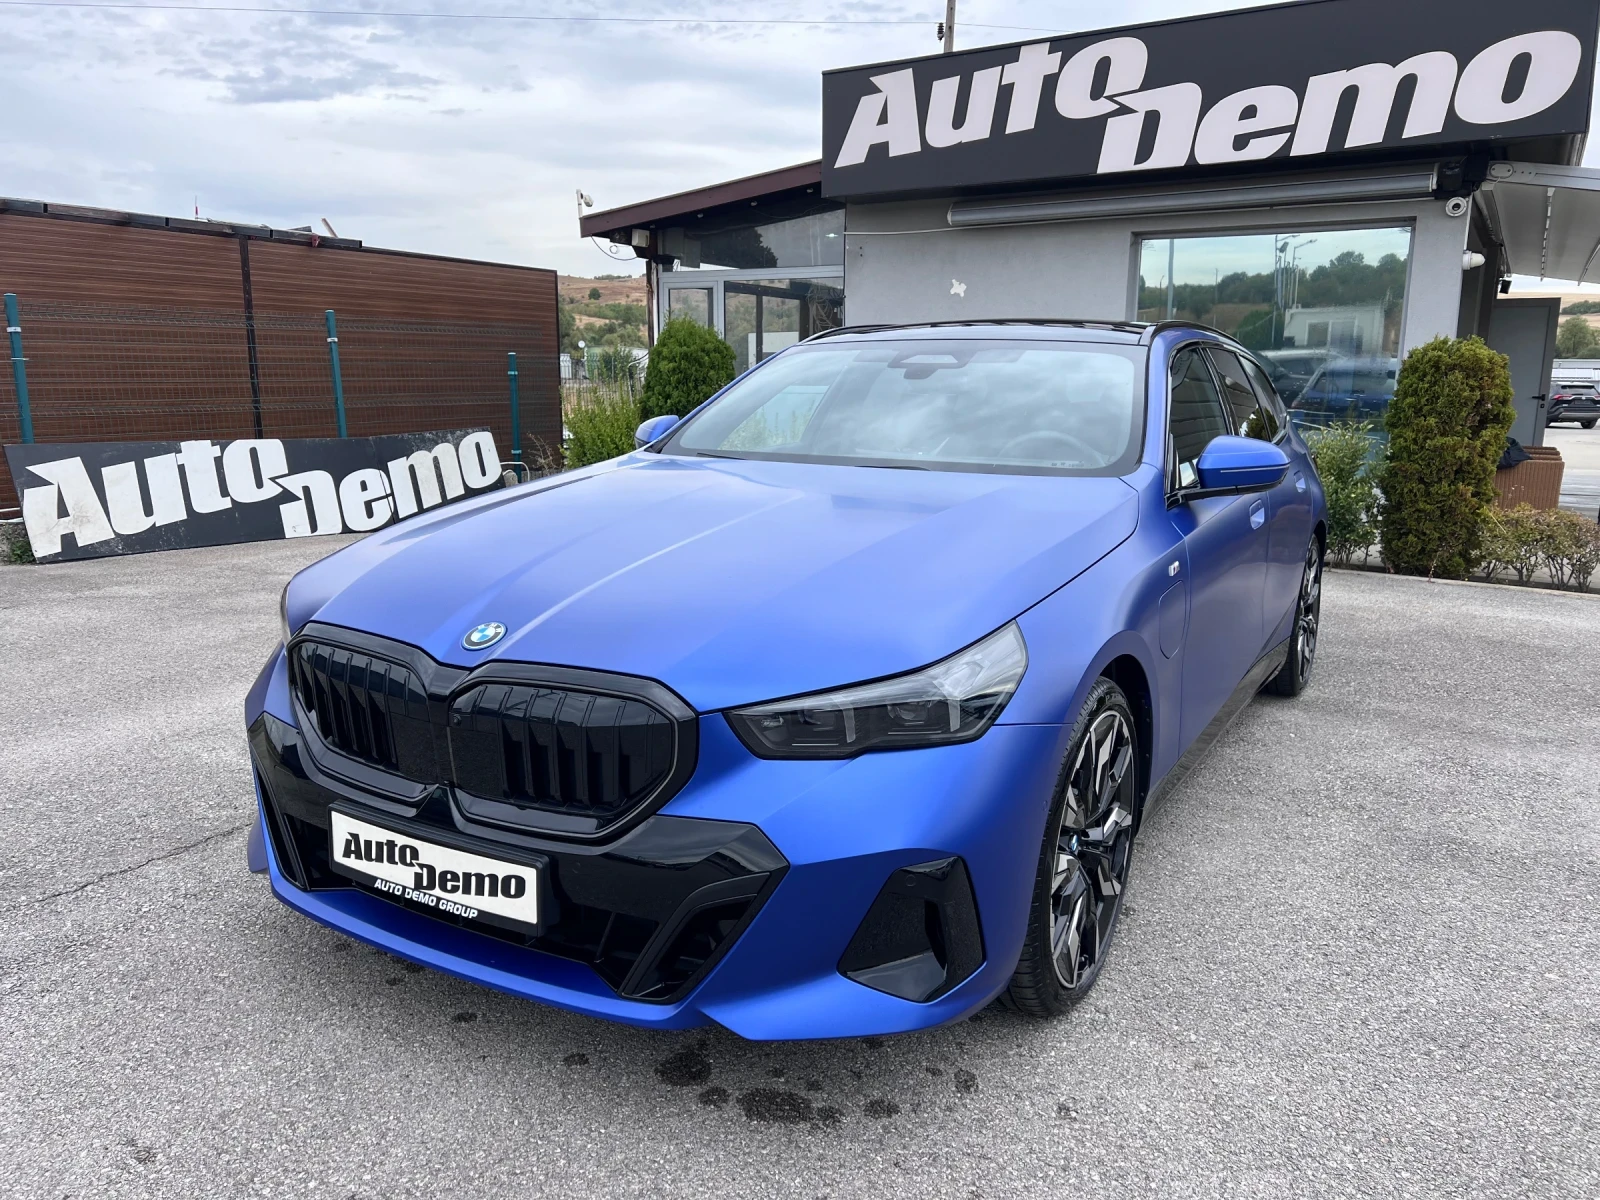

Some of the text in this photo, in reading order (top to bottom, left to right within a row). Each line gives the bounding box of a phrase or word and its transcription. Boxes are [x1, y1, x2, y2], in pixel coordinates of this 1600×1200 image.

[834, 31, 1582, 174] Auto Demo
[23, 430, 502, 559] Auto Demo
[342, 832, 526, 899] Auto Demo
[374, 879, 478, 919] AUTO DEMO GROUP
